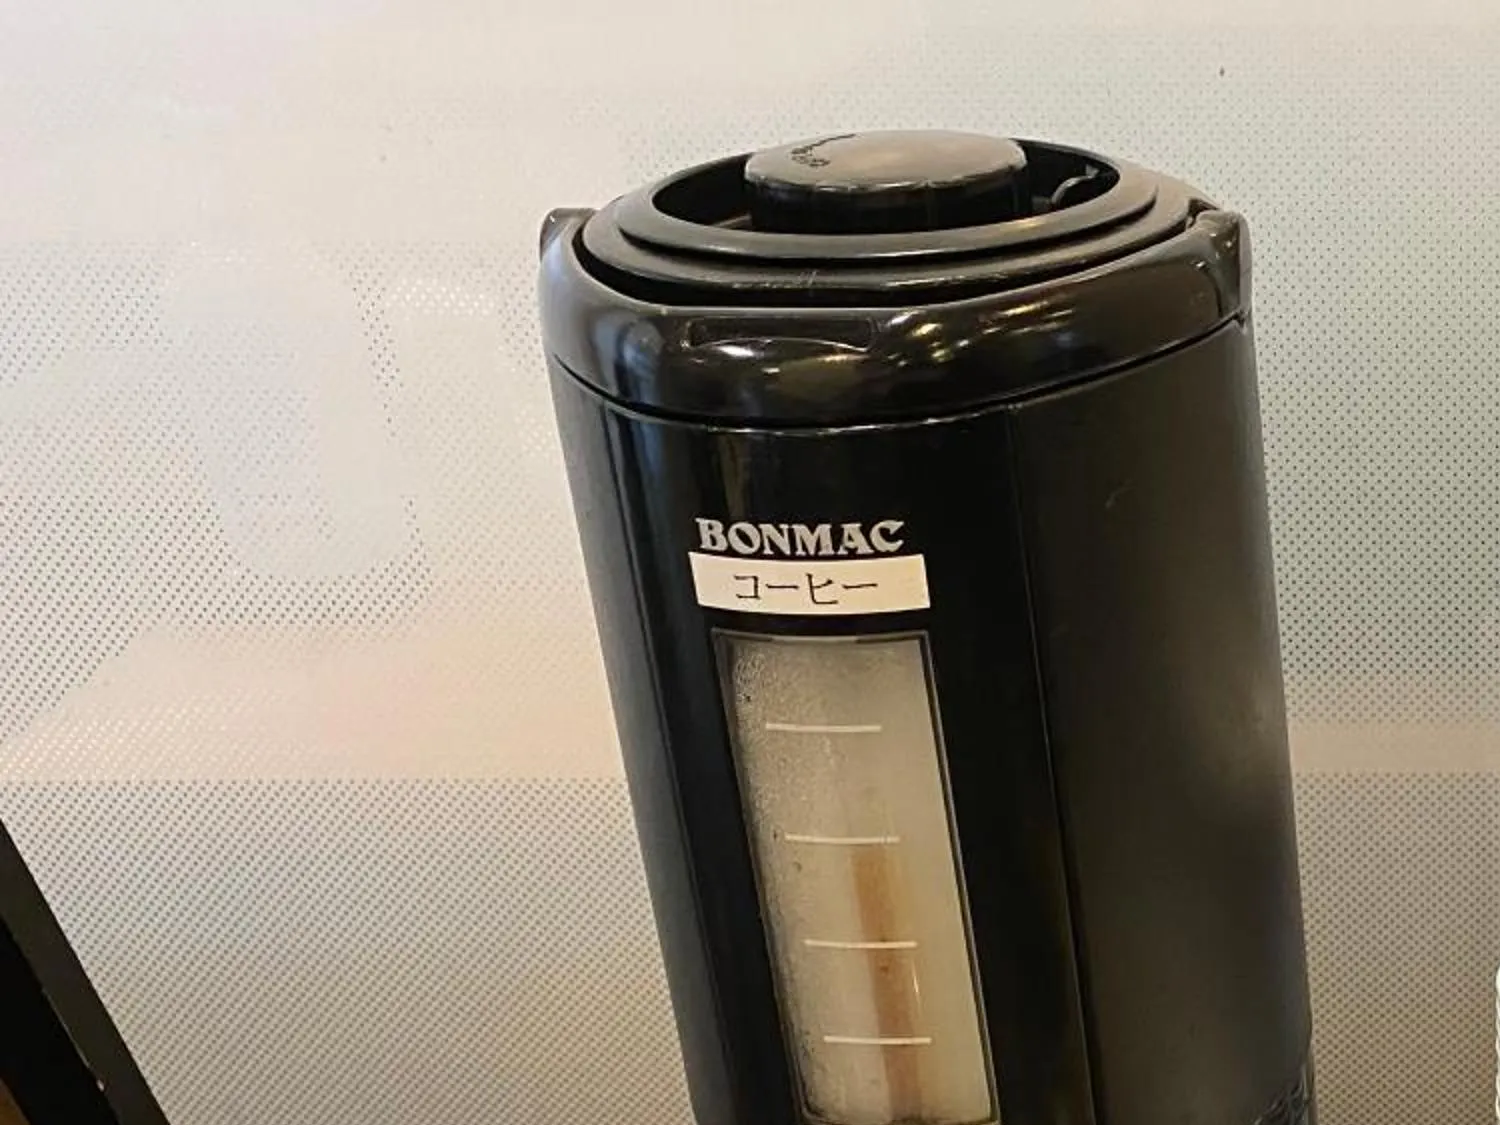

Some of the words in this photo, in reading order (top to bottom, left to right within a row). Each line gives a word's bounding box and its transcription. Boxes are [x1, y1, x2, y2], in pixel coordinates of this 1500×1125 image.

[695, 517, 904, 556] BONMAC
[733, 573, 878, 604] コーヒー
